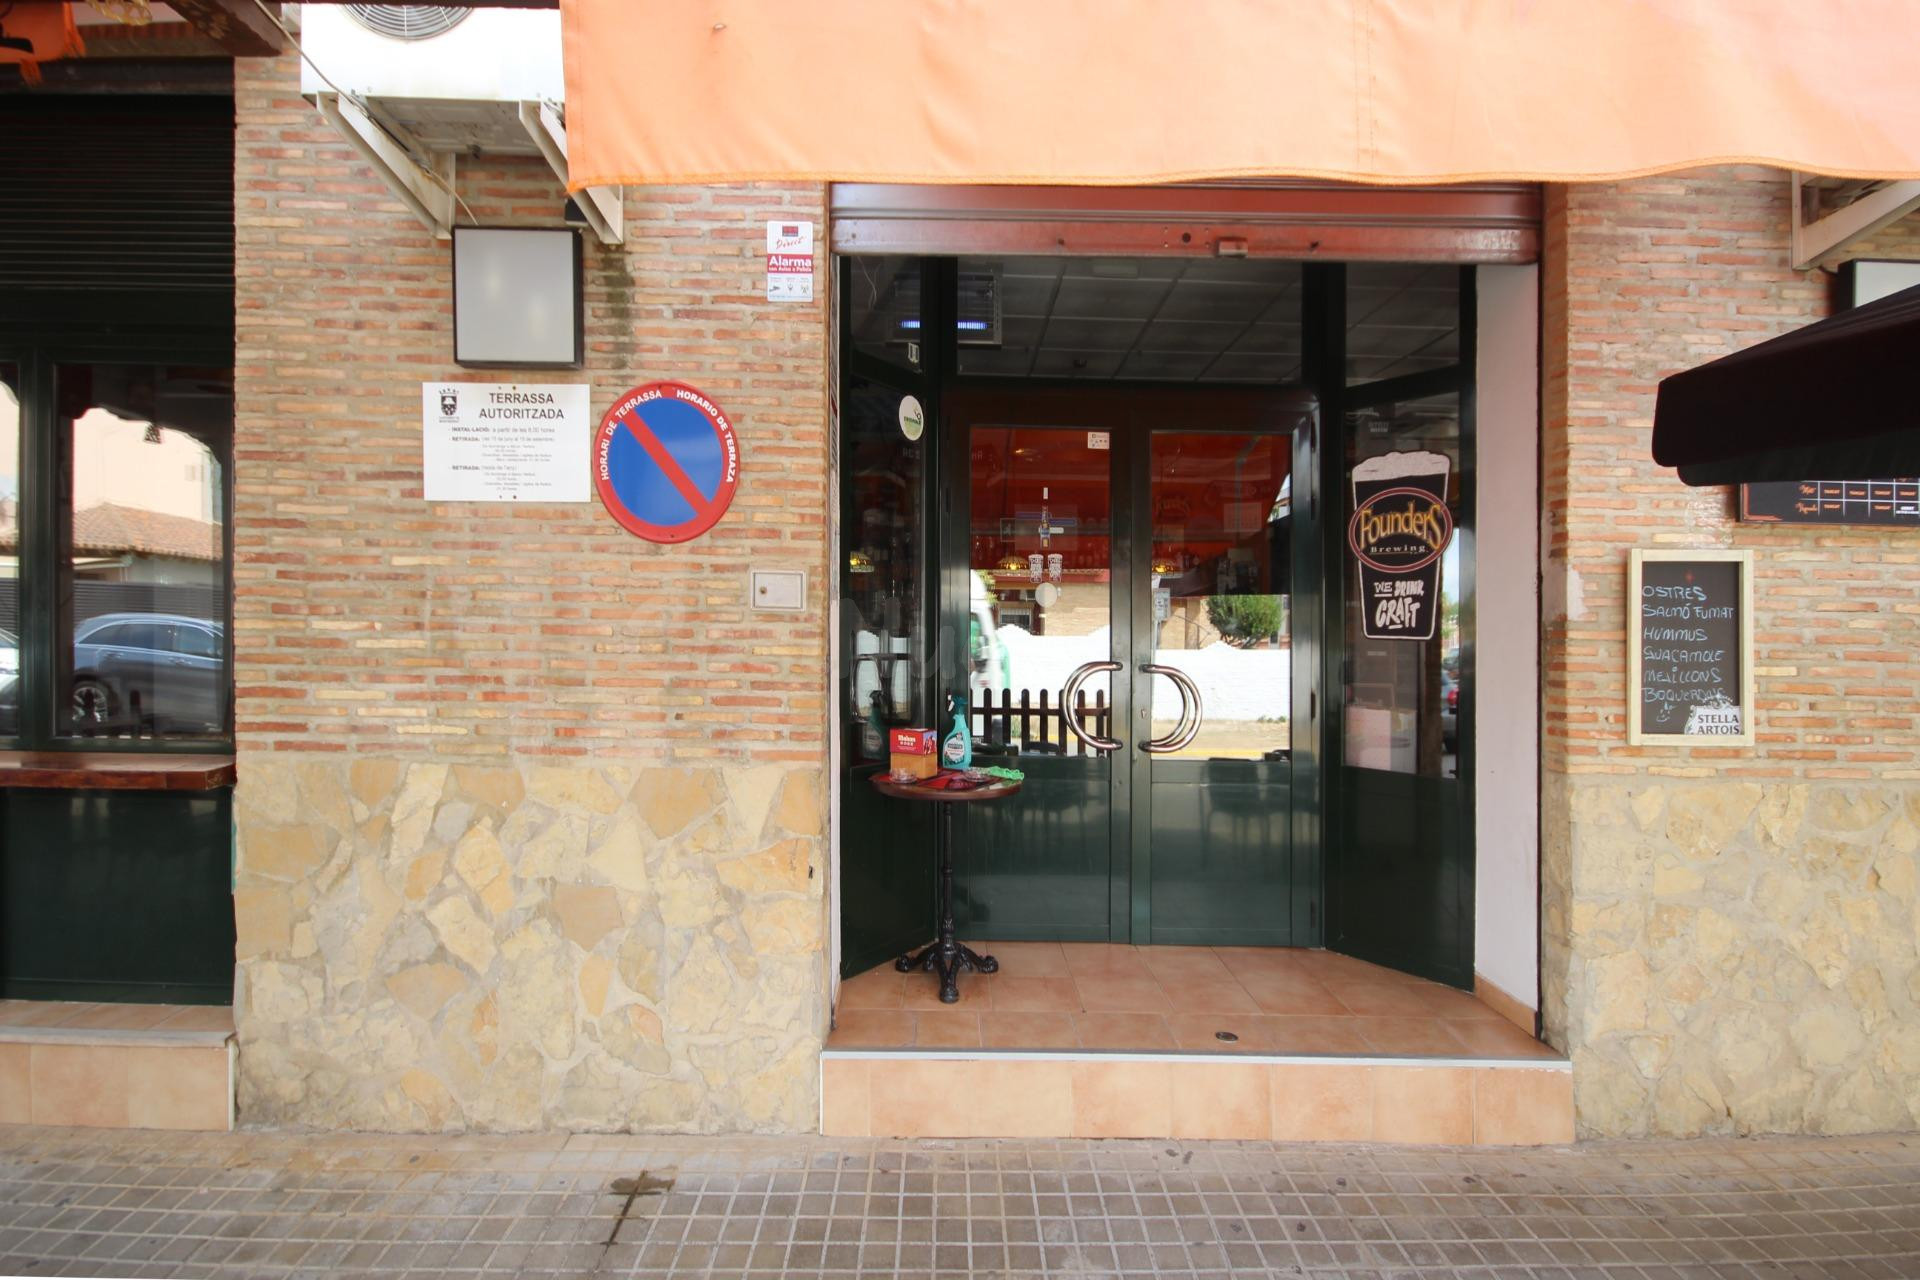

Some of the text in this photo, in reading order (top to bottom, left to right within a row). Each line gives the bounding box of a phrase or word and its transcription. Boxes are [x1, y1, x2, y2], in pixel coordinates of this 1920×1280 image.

[769, 255, 812, 267] Alarma
[489, 393, 554, 404] TERRASSA
[478, 408, 565, 420] AUTORITZADA
[600, 389, 662, 480] HORARI DE TERRASSA
[676, 389, 736, 483] HORARIO DE TERRAZA
[1371, 544, 1426, 553] Brewing
[1374, 579, 1424, 596] WE DRINK
[1642, 586, 1707, 601] OSTRES
[1375, 598, 1420, 629] CRAFT
[1642, 602, 1734, 619] SALMÓ FUMAT
[1643, 626, 1708, 641] HUMMUS
[1697, 714, 1739, 723] STELLA
[1697, 725, 1740, 735] ARTOIS
